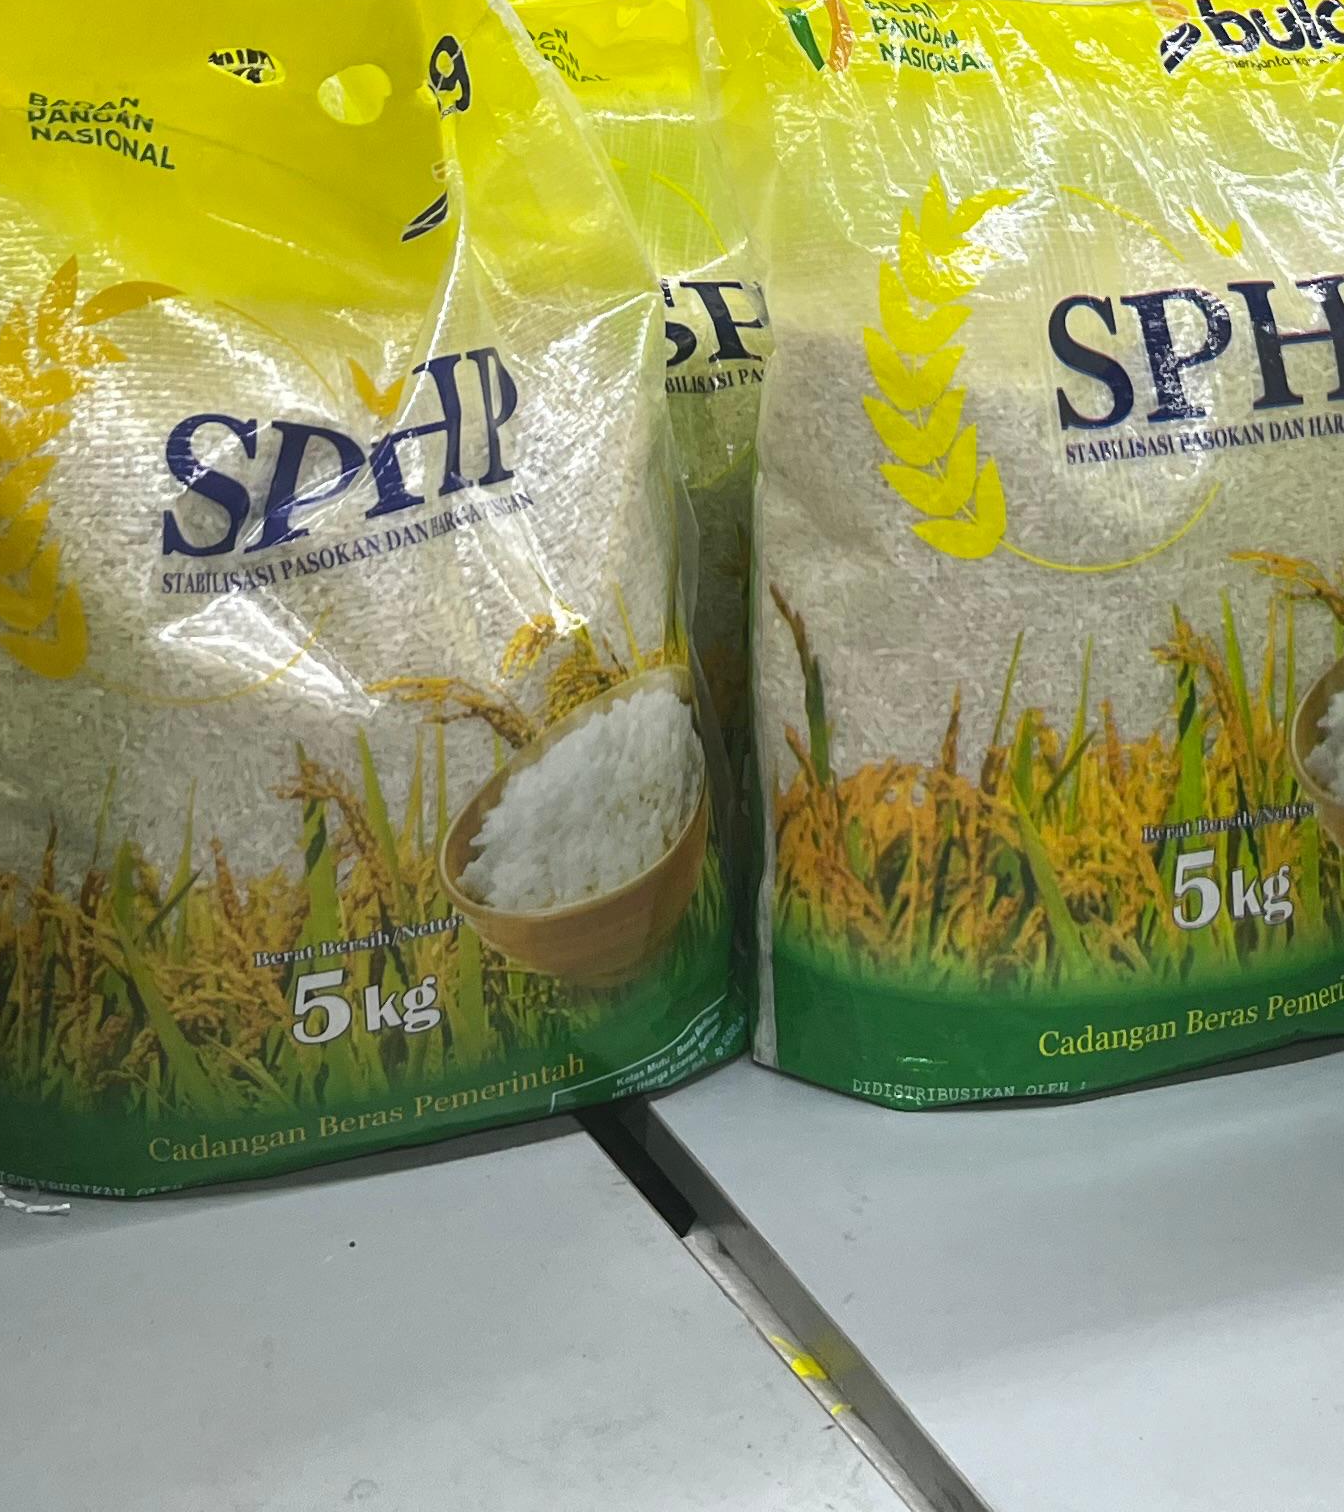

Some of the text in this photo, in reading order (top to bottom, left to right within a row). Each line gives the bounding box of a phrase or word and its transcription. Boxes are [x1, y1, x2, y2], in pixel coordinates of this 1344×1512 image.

[30, 125, 176, 170] NASIONAL
[162, 346, 519, 557] SPHP
[1065, 434, 1176, 465] STABILISASI
[1178, 422, 1265, 454] PASOKAN
[1269, 417, 1306, 442] DAN
[161, 564, 276, 594] STABILISASI
[281, 533, 382, 580] PASOKAN
[385, 521, 431, 554] DAN
[430, 503, 482, 538] HARGA
[1231, 862, 1294, 926] kg
[254, 940, 315, 968] Berat
[362, 974, 443, 1033] kg
[1038, 1015, 1179, 1060] Cadangan
[1186, 1003, 1259, 1036] Beras
[148, 1052, 586, 1165] Cadangan Beras Pemerintah
[852, 1077, 1015, 1103] DIDISTRIBUSIKAN
